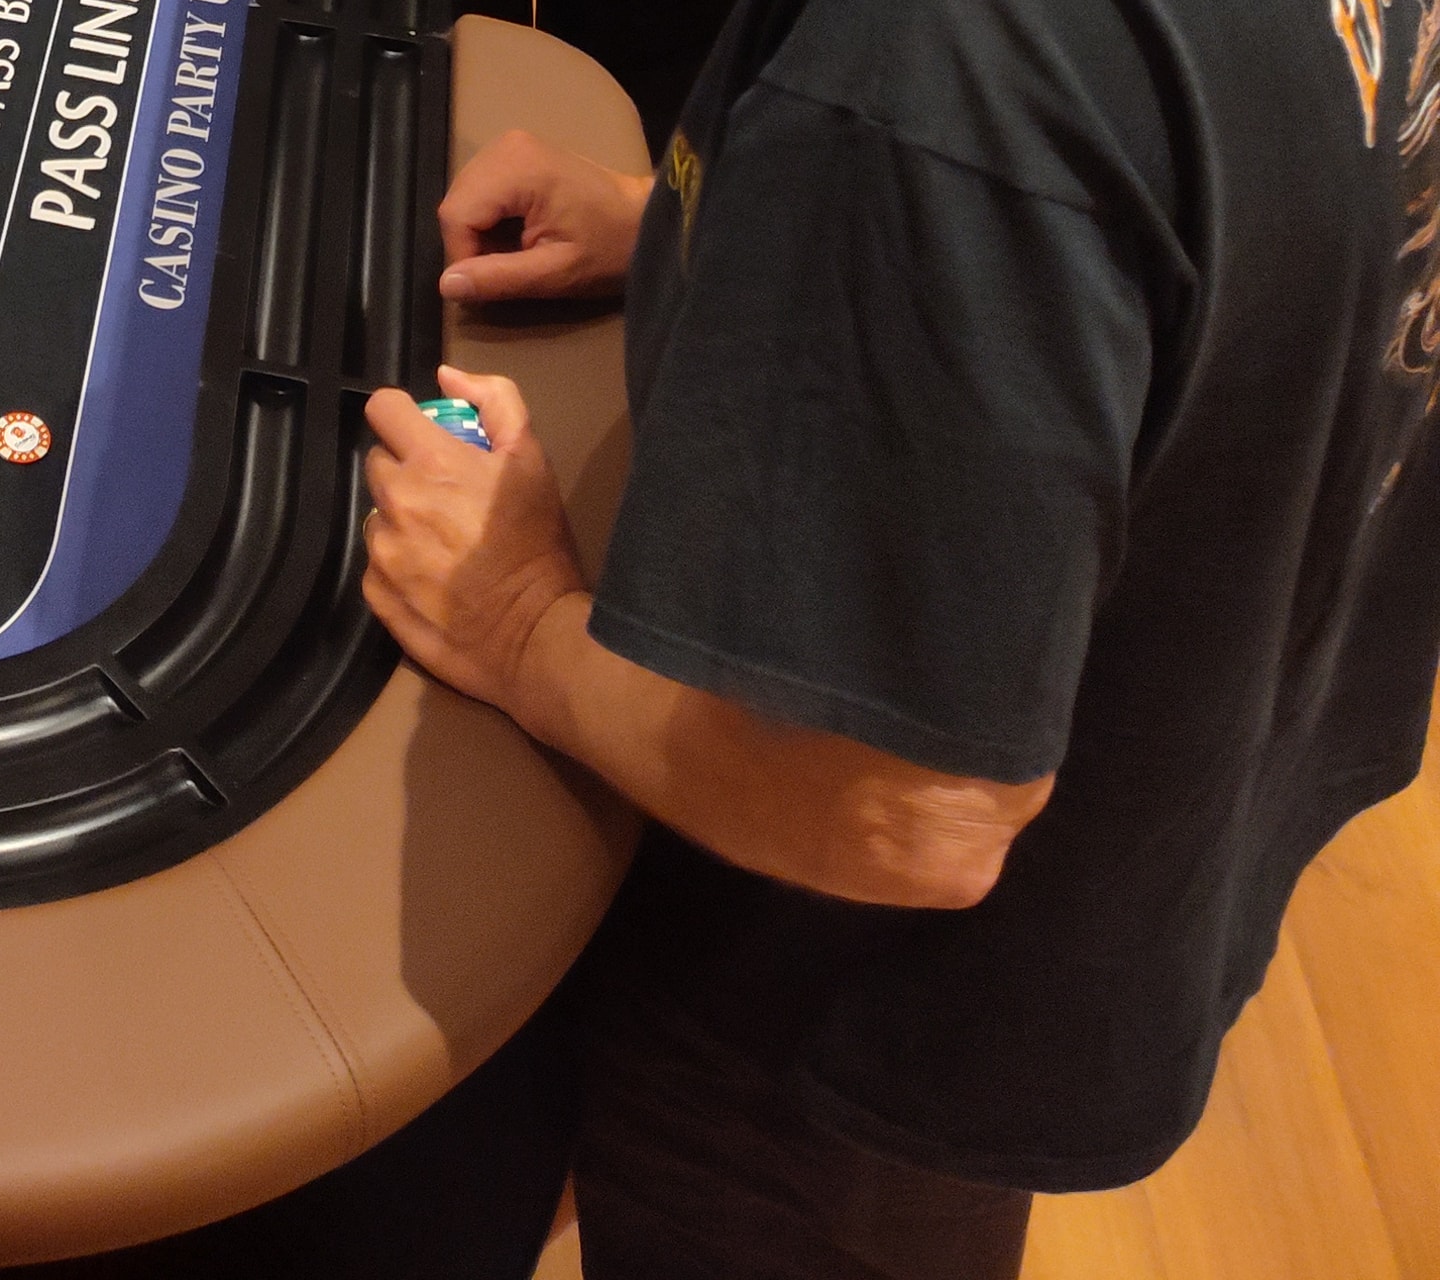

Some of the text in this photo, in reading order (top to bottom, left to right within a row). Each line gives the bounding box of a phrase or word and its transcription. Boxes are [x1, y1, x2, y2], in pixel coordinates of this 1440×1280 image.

[166, 15, 228, 143] PARTY
[30, 89, 119, 231] PASS
[137, 147, 207, 311] CASINO
